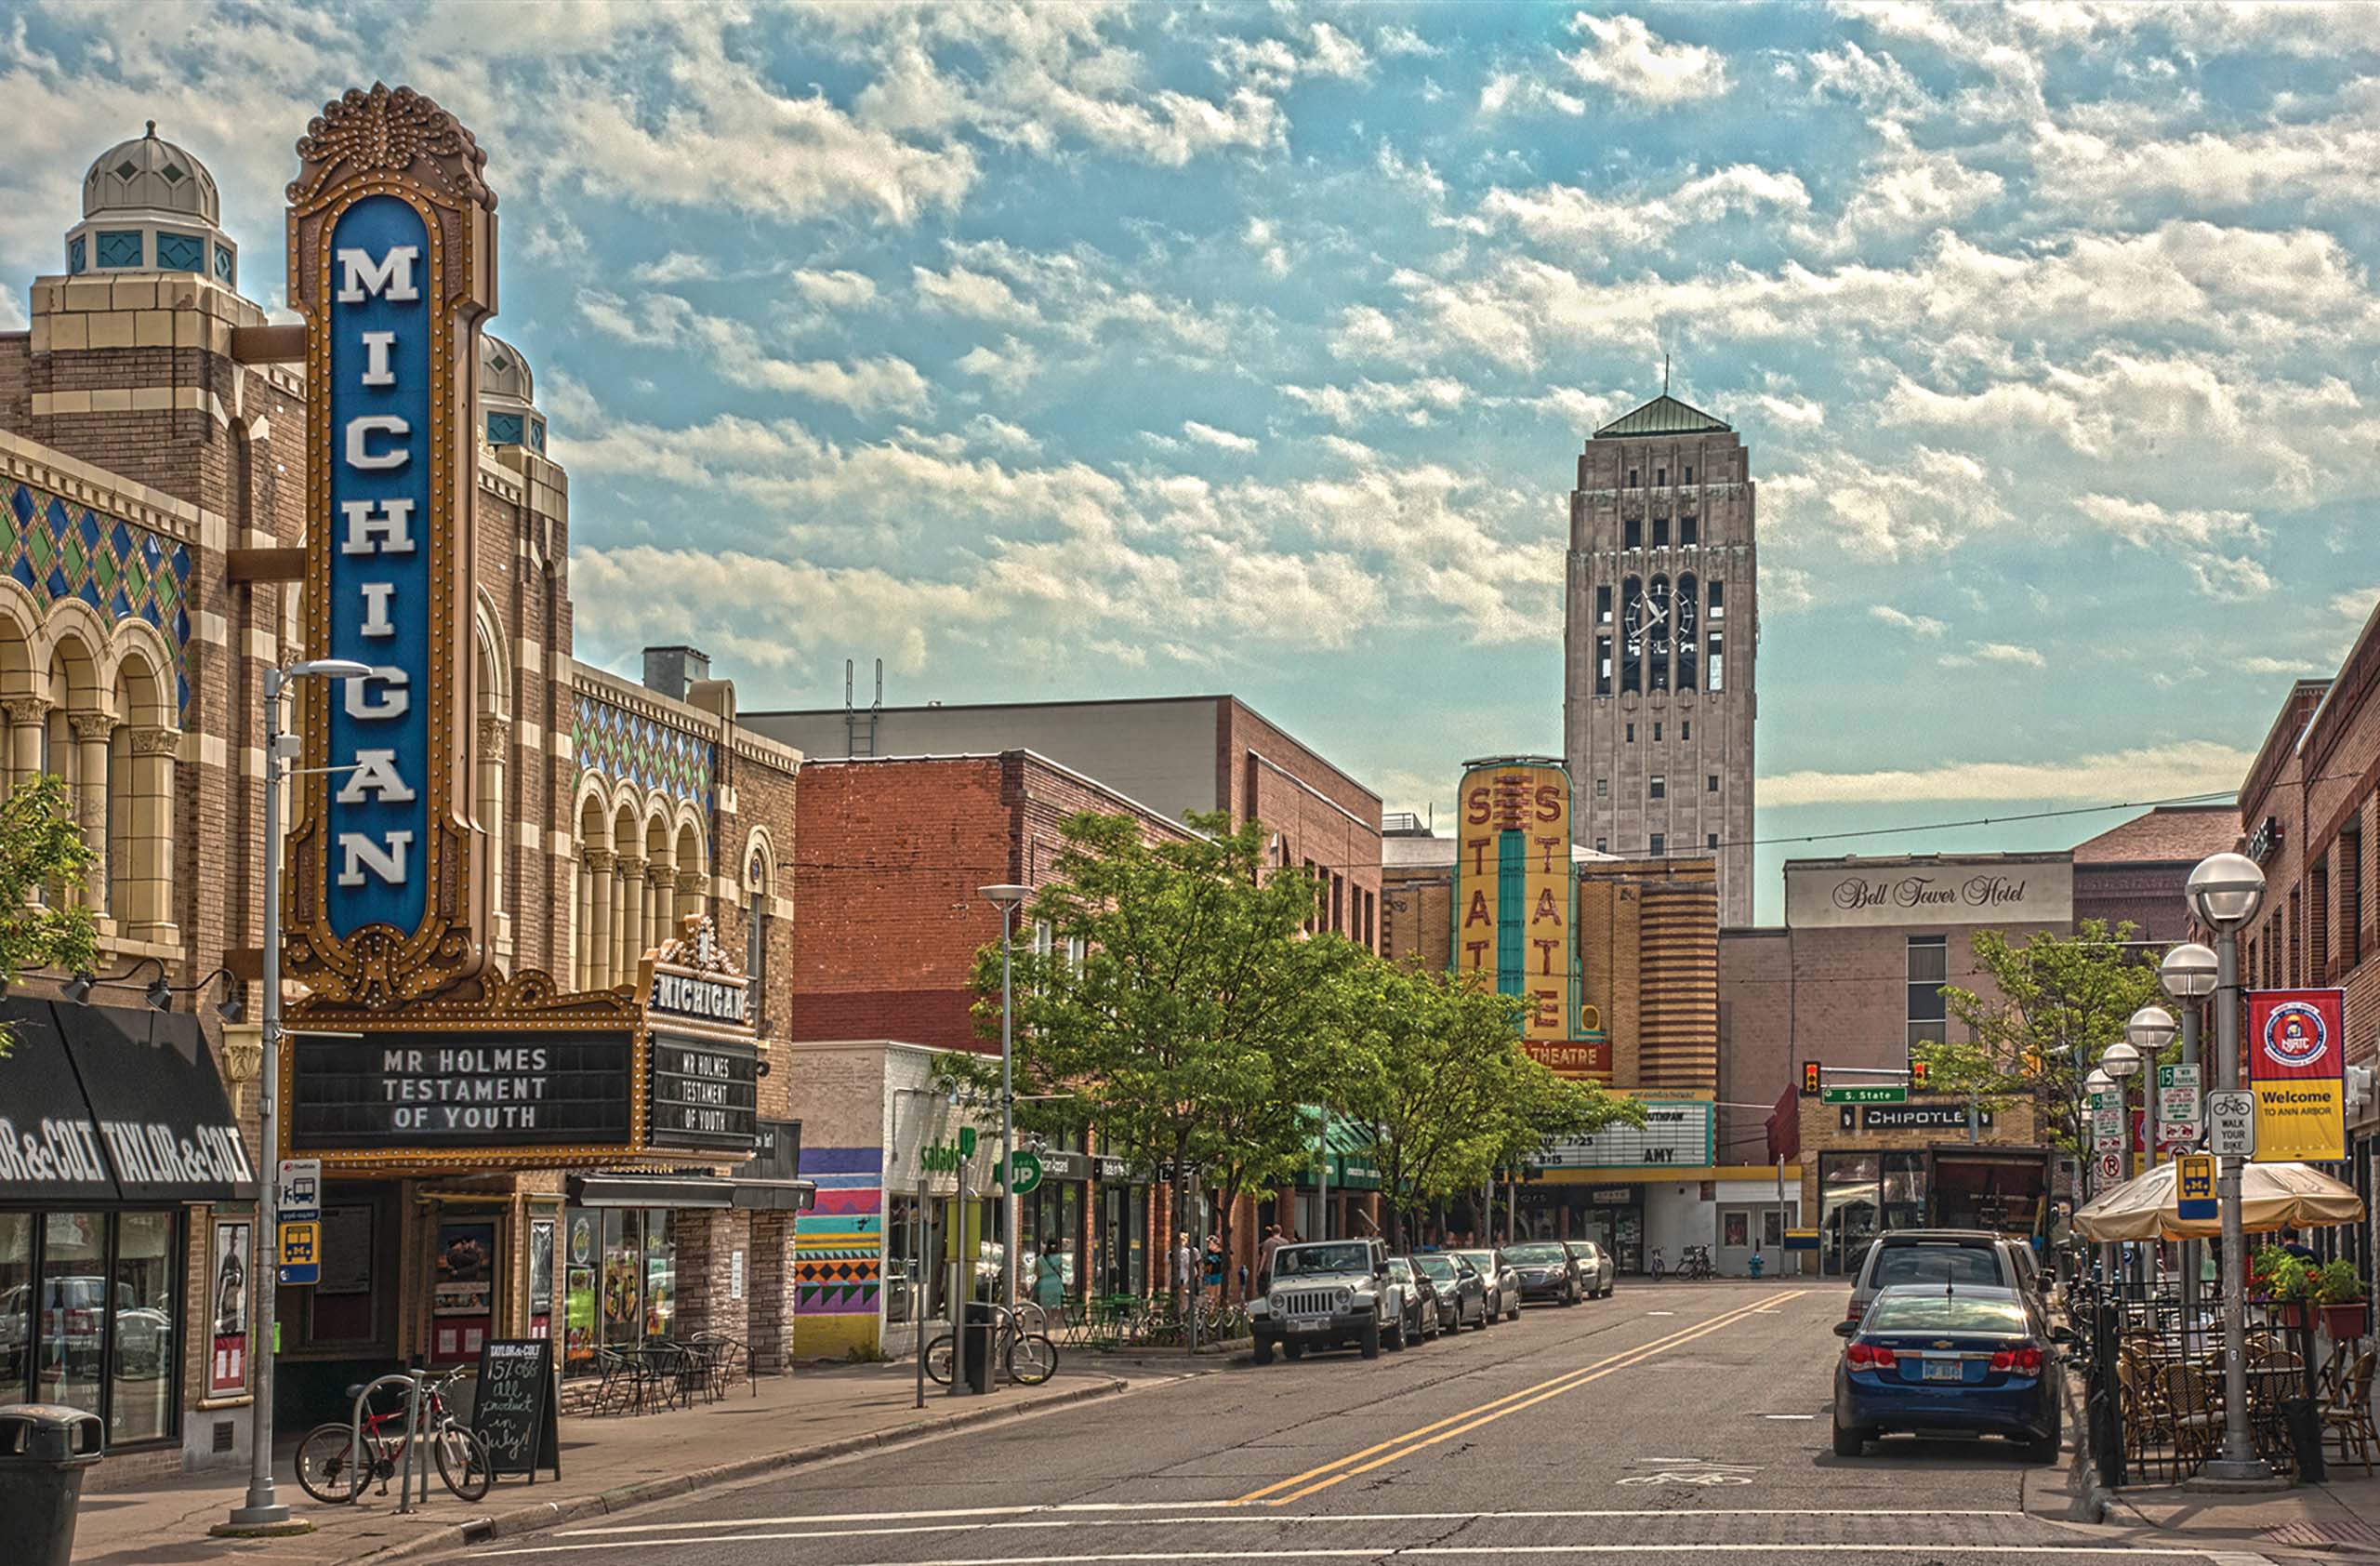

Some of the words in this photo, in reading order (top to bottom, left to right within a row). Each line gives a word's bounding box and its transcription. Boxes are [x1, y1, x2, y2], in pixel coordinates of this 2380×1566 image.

[337, 246, 420, 888] MICHIGAN
[1464, 788, 1493, 997] STAT
[1832, 877, 1887, 909] Bell
[1894, 877, 1956, 908] Tower
[1963, 875, 2026, 907] Hotel
[1532, 786, 1562, 1028] STATE
[657, 975, 747, 1020] MICHIGAN
[383, 1049, 423, 1072] MR
[440, 1048, 547, 1072] HOLMES
[682, 1053, 695, 1075] MR
[698, 1055, 729, 1079] HOLMES
[1532, 1047, 1597, 1065] THEATRE
[2161, 1069, 2173, 1085] 15
[383, 1077, 547, 1101] TESTAMENT
[682, 1081, 727, 1105] TESTAMENT
[1844, 1092, 1855, 1100] S.
[1859, 1091, 1891, 1100] State
[2262, 1091, 2331, 1104] Welcome
[394, 1107, 428, 1128] OF
[444, 1106, 536, 1129] YOUTH
[685, 1108, 695, 1129] OF
[700, 1110, 725, 1132] YOUTH
[1869, 1111, 1965, 1123] CHIPOTLE
[2278, 1108, 2298, 1116] ANN
[2301, 1107, 2332, 1115] ARBOR
[2222, 1130, 2245, 1139] YOUR
[2223, 1141, 2242, 1150] BIKE
[101, 1121, 253, 1182] TAYLOR&COLT
[1644, 1148, 1674, 1163] AMY
[488, 1360, 513, 1380] 15%
[515, 1360, 538, 1378] off
[493, 1380, 522, 1398] all
[481, 1393, 533, 1419] product
[489, 1418, 516, 1429] in
